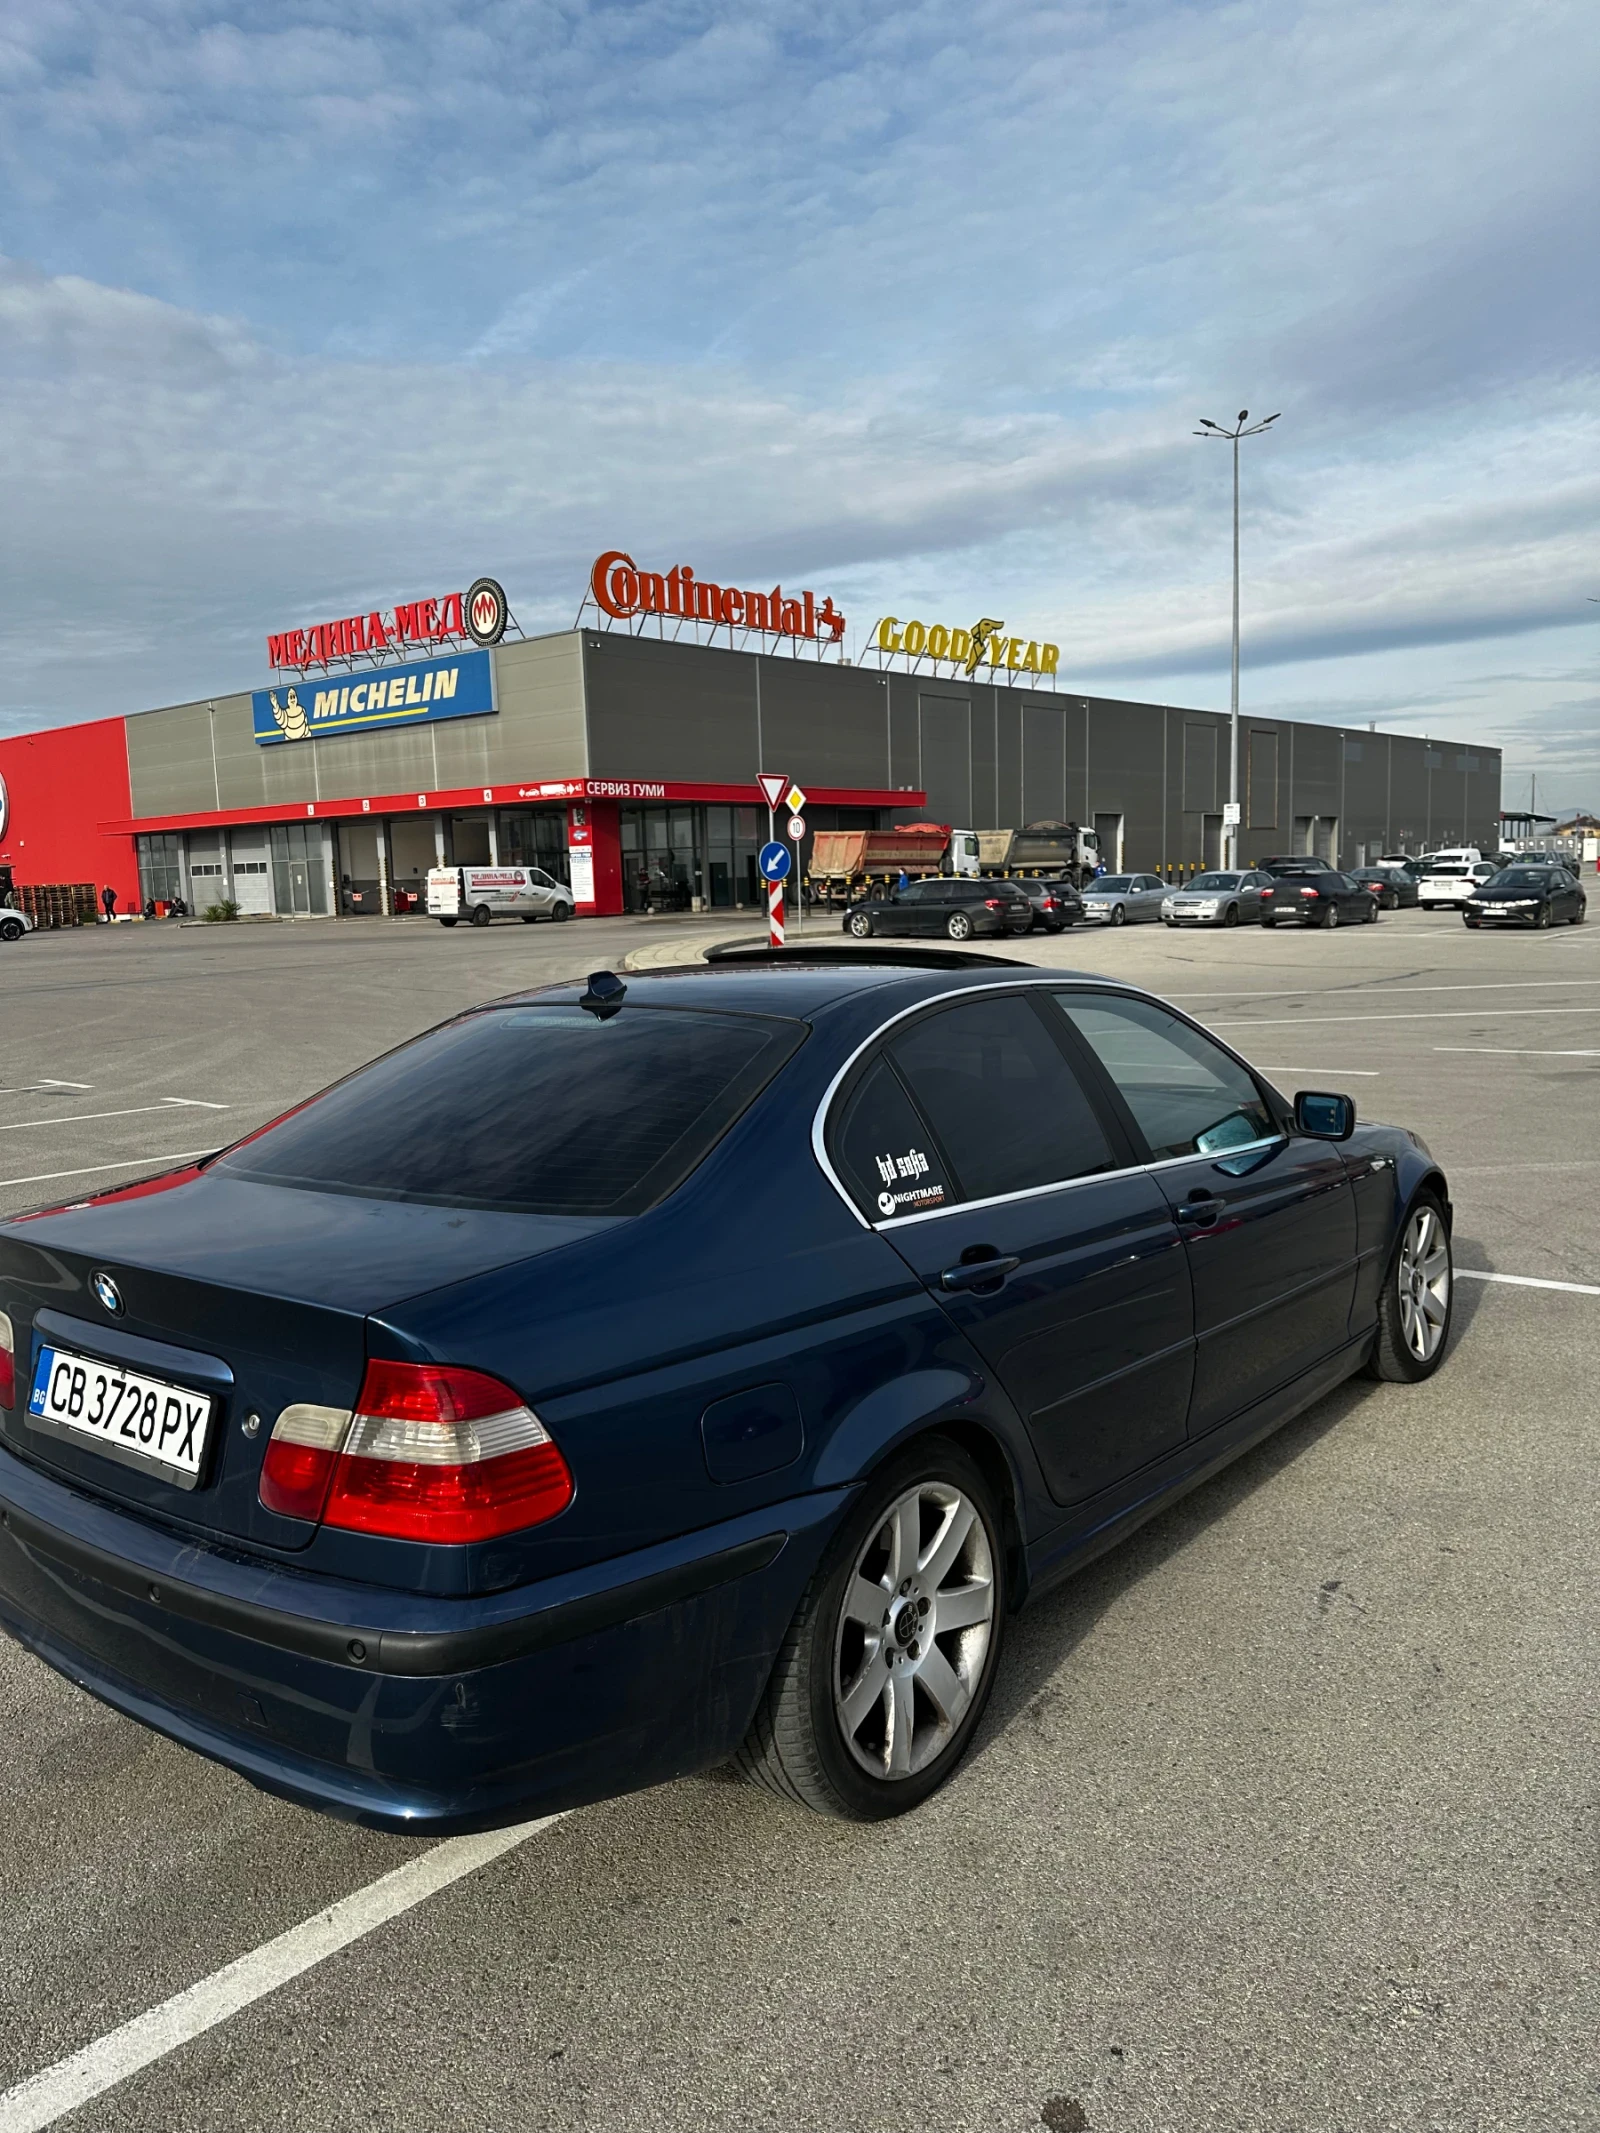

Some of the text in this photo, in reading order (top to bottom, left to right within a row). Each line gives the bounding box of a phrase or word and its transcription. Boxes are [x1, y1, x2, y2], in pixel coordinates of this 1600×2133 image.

[591, 550, 816, 638] Continental
[267, 592, 467, 671] МЕДИНА-МЕД
[313, 668, 459, 719] MICHELIN
[586, 781, 665, 797] СЕРВИЗ ГУМИ
[792, 821, 800, 834] 10
[893, 1185, 944, 1204] NIGHTMARE
[913, 1195, 945, 1208] MOTORSPORT
[33, 1388, 46, 1405] BG
[51, 1362, 203, 1462] CB 3728 PX
